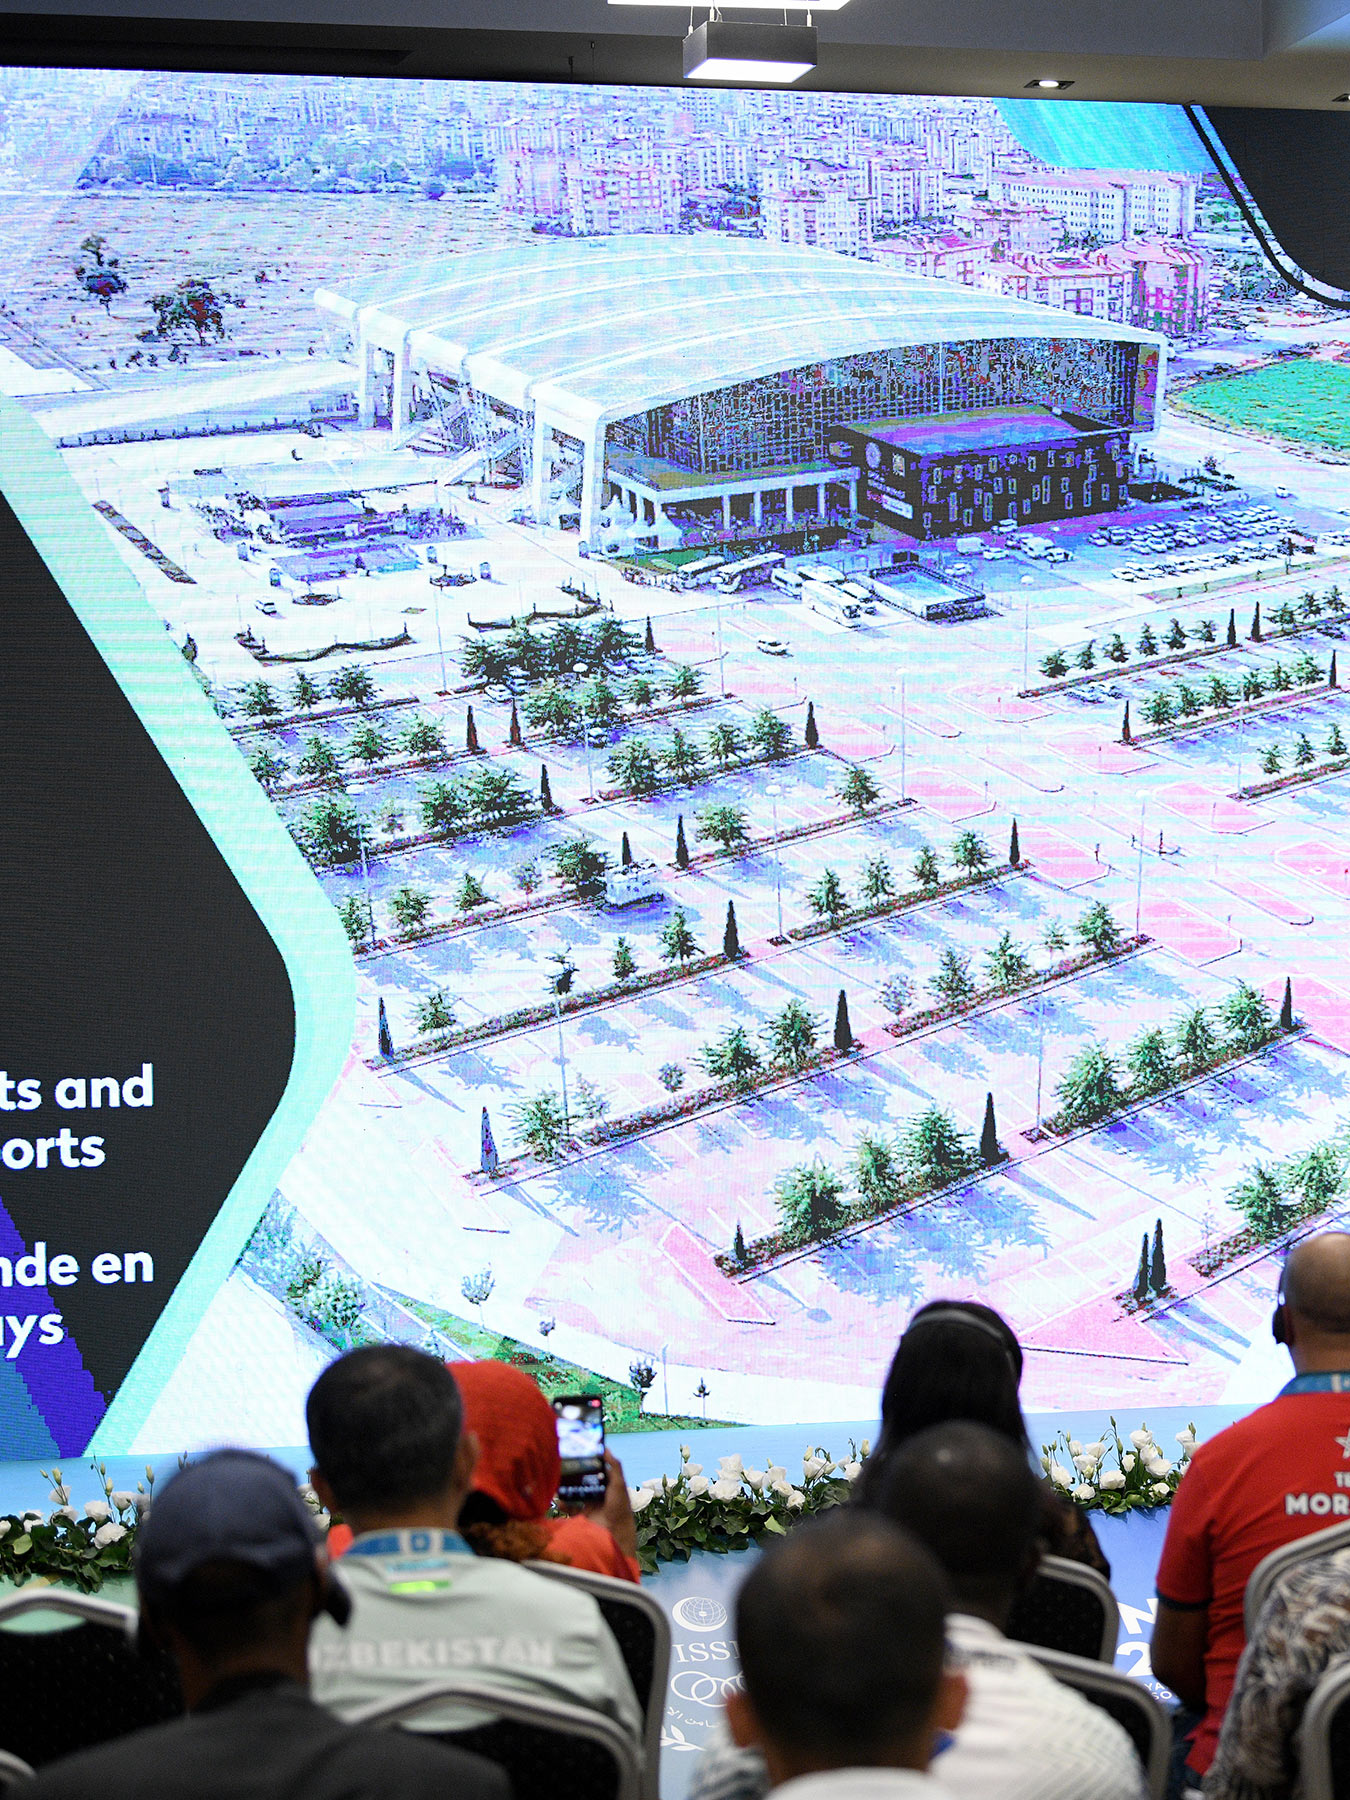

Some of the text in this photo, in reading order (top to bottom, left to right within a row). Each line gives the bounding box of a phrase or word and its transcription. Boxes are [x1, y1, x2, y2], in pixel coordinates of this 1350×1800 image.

[55, 1063, 154, 1109] and
[91, 1251, 154, 1284] en
[0, 1312, 65, 1359] ys
